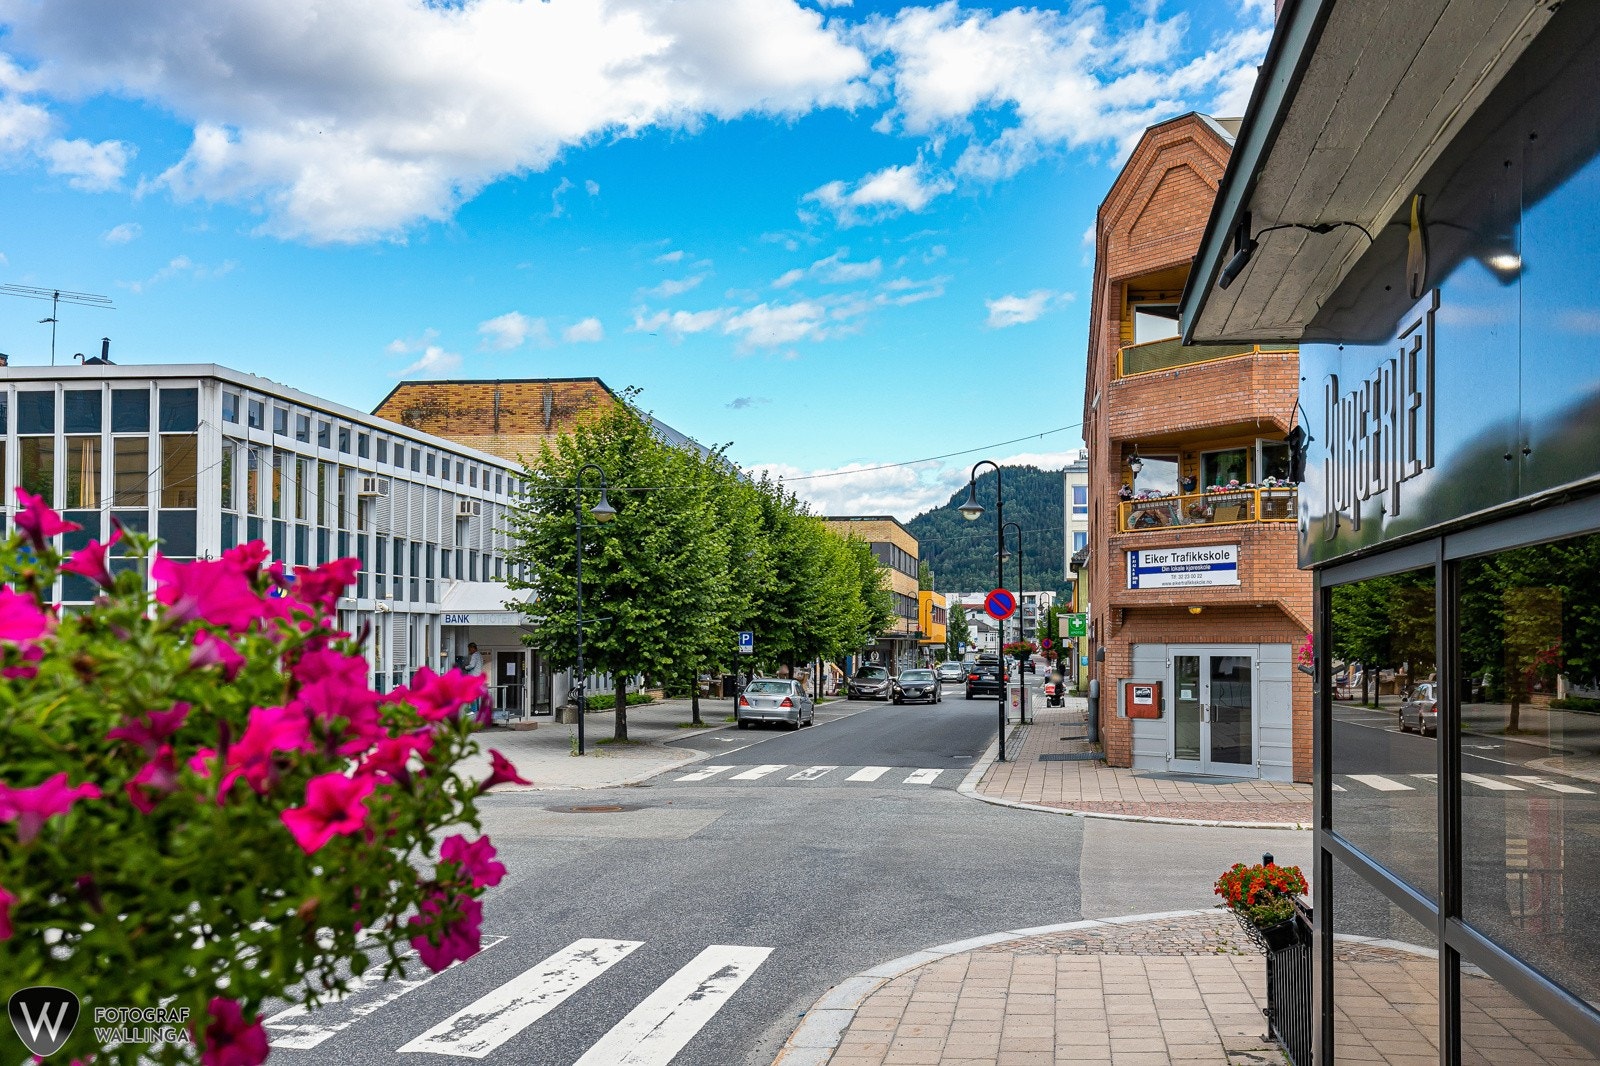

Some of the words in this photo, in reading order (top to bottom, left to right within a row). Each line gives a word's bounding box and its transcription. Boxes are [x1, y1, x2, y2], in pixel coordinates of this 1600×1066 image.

[1323, 288, 1441, 542] BURGERIET
[1144, 553, 1169, 564] Eiker
[1171, 550, 1230, 563] Trafikkskole
[445, 614, 470, 624] BANK
[742, 634, 750, 644] P
